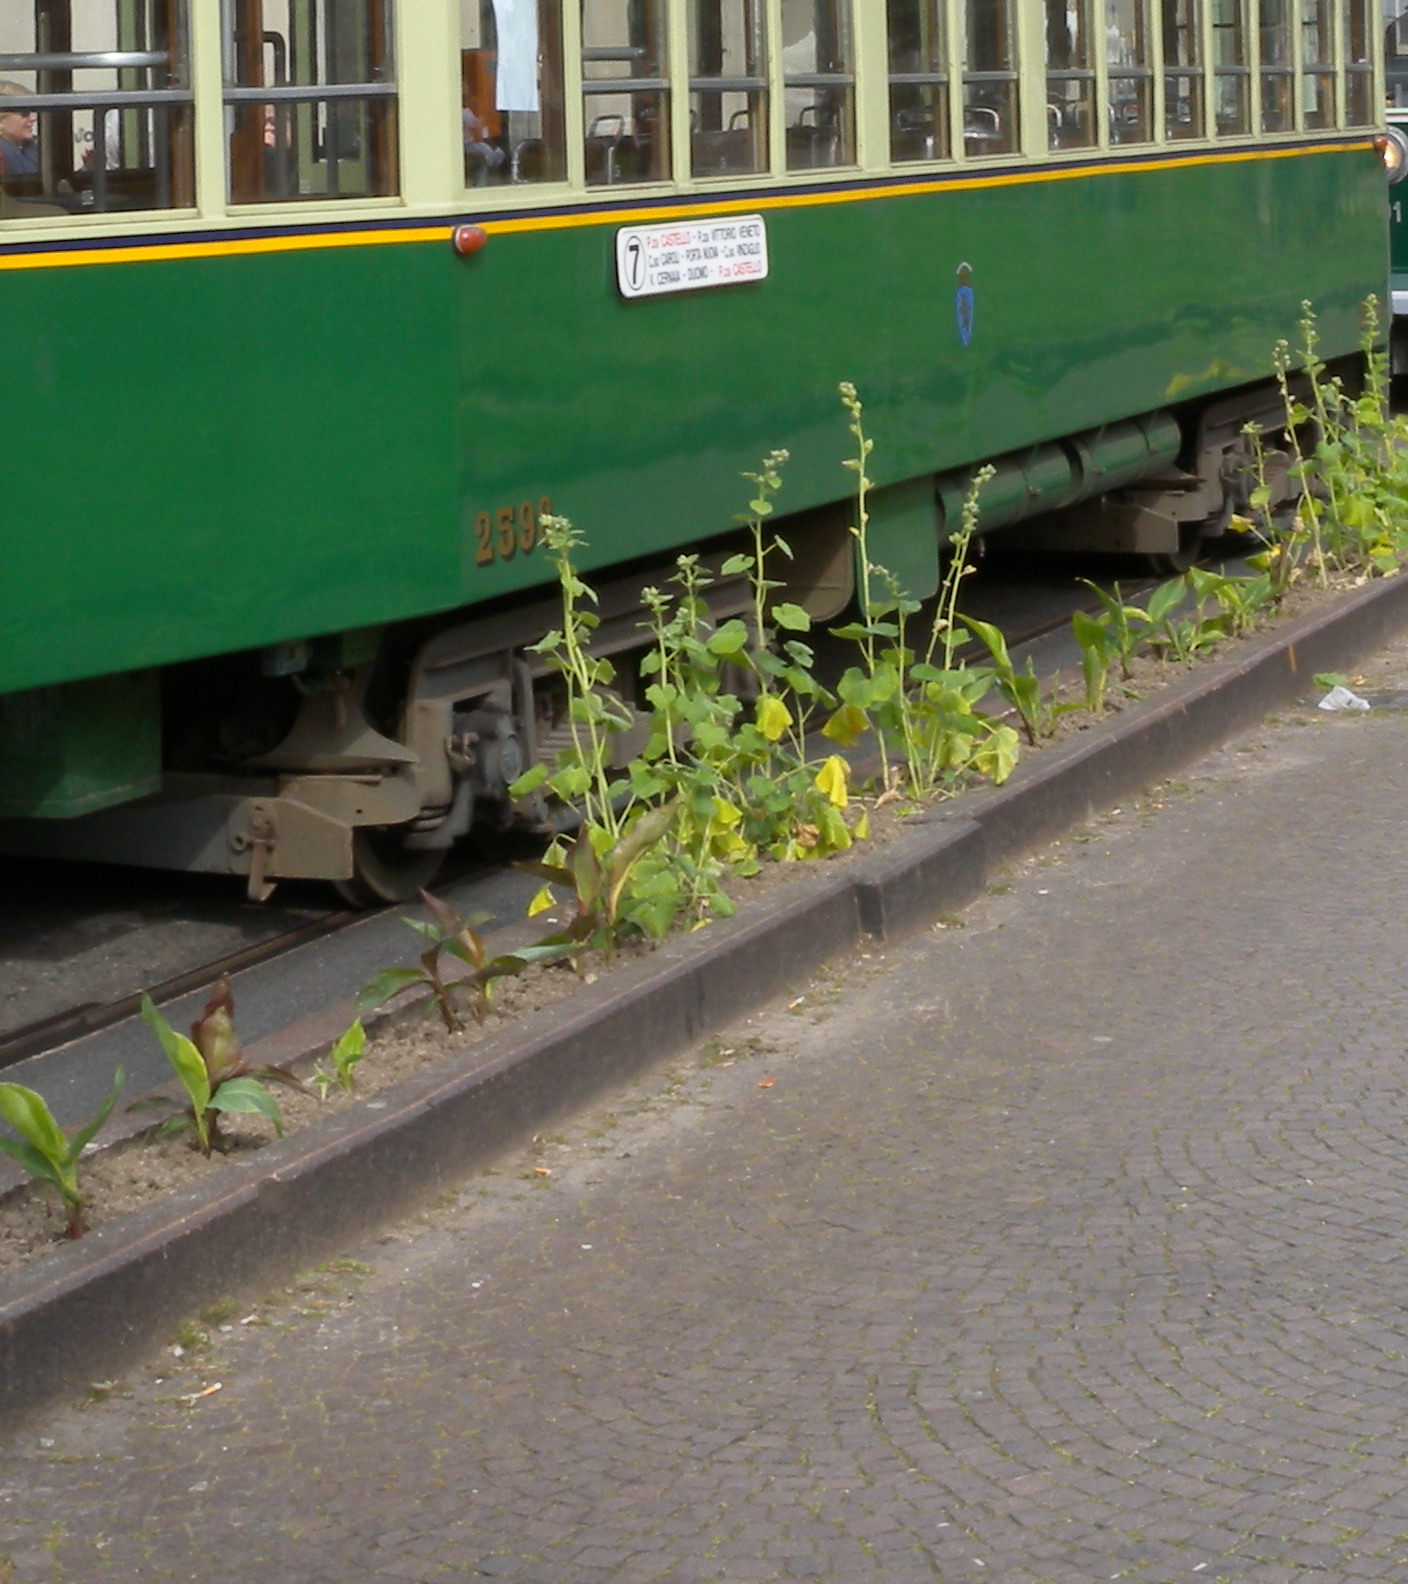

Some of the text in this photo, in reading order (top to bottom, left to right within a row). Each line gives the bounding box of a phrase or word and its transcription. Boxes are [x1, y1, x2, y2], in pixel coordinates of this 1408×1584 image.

[661, 231, 691, 247] CASTELLO
[739, 224, 760, 239] VENETO
[629, 244, 640, 285] 7
